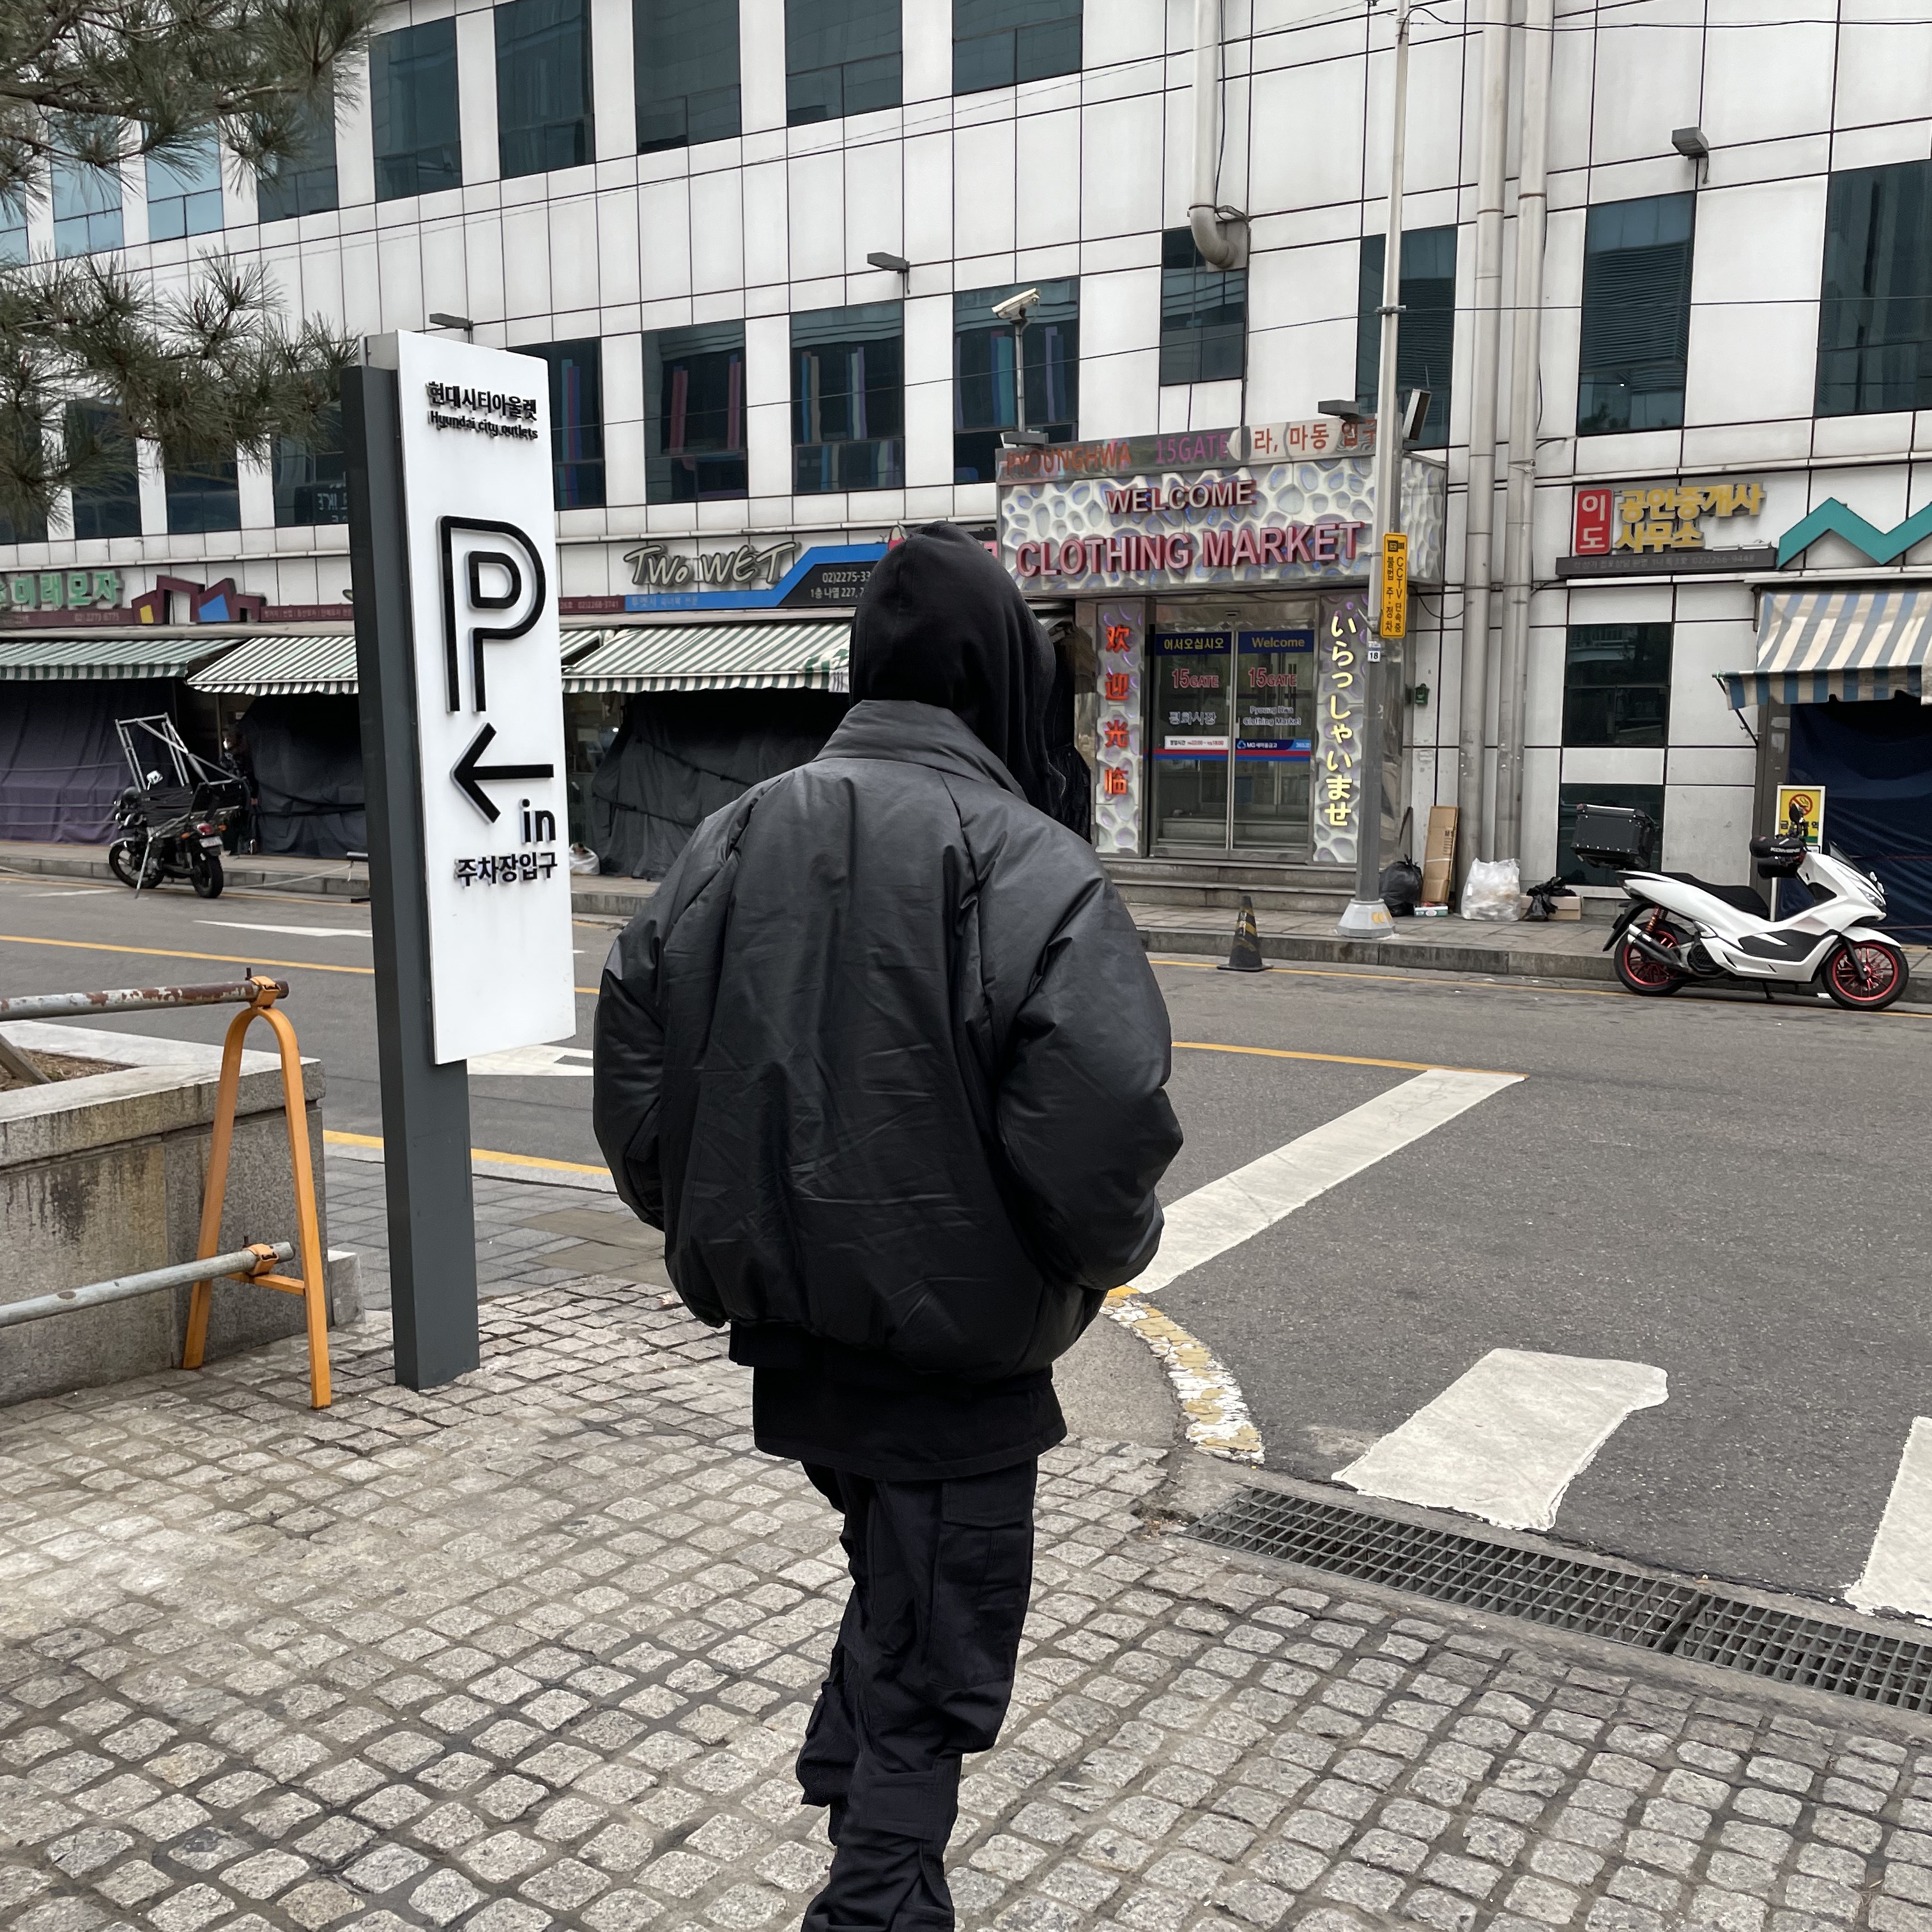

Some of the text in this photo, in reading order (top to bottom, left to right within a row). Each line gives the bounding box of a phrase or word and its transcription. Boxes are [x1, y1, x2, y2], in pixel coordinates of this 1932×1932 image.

[426, 381, 537, 421] 현대시티아울렛
[429, 411, 538, 440] Hyundai city outlets
[1006, 440, 1133, 475] PYOUNGHWA
[1156, 433, 1228, 465] 15GATE
[1254, 427, 1278, 454] 라,
[1290, 424, 1330, 451] 마동
[1106, 479, 1257, 515] WELCOME
[1618, 484, 1767, 523] 공인중개사
[1579, 494, 1606, 550] 이도
[1615, 518, 1705, 553] 사무소
[700, 540, 802, 586] WET
[1016, 520, 1365, 578] CLOTHING MARKET
[1395, 556, 1404, 599] CCTV
[1164, 638, 1224, 650] 어서오십시오
[1252, 636, 1305, 648] Welcome
[1105, 624, 1130, 796] 欢迎光临
[1275, 716, 1302, 726] Market
[1324, 610, 1357, 827] いらっしゃいませ
[520, 798, 556, 843] in
[454, 851, 558, 887] 주차장입구
